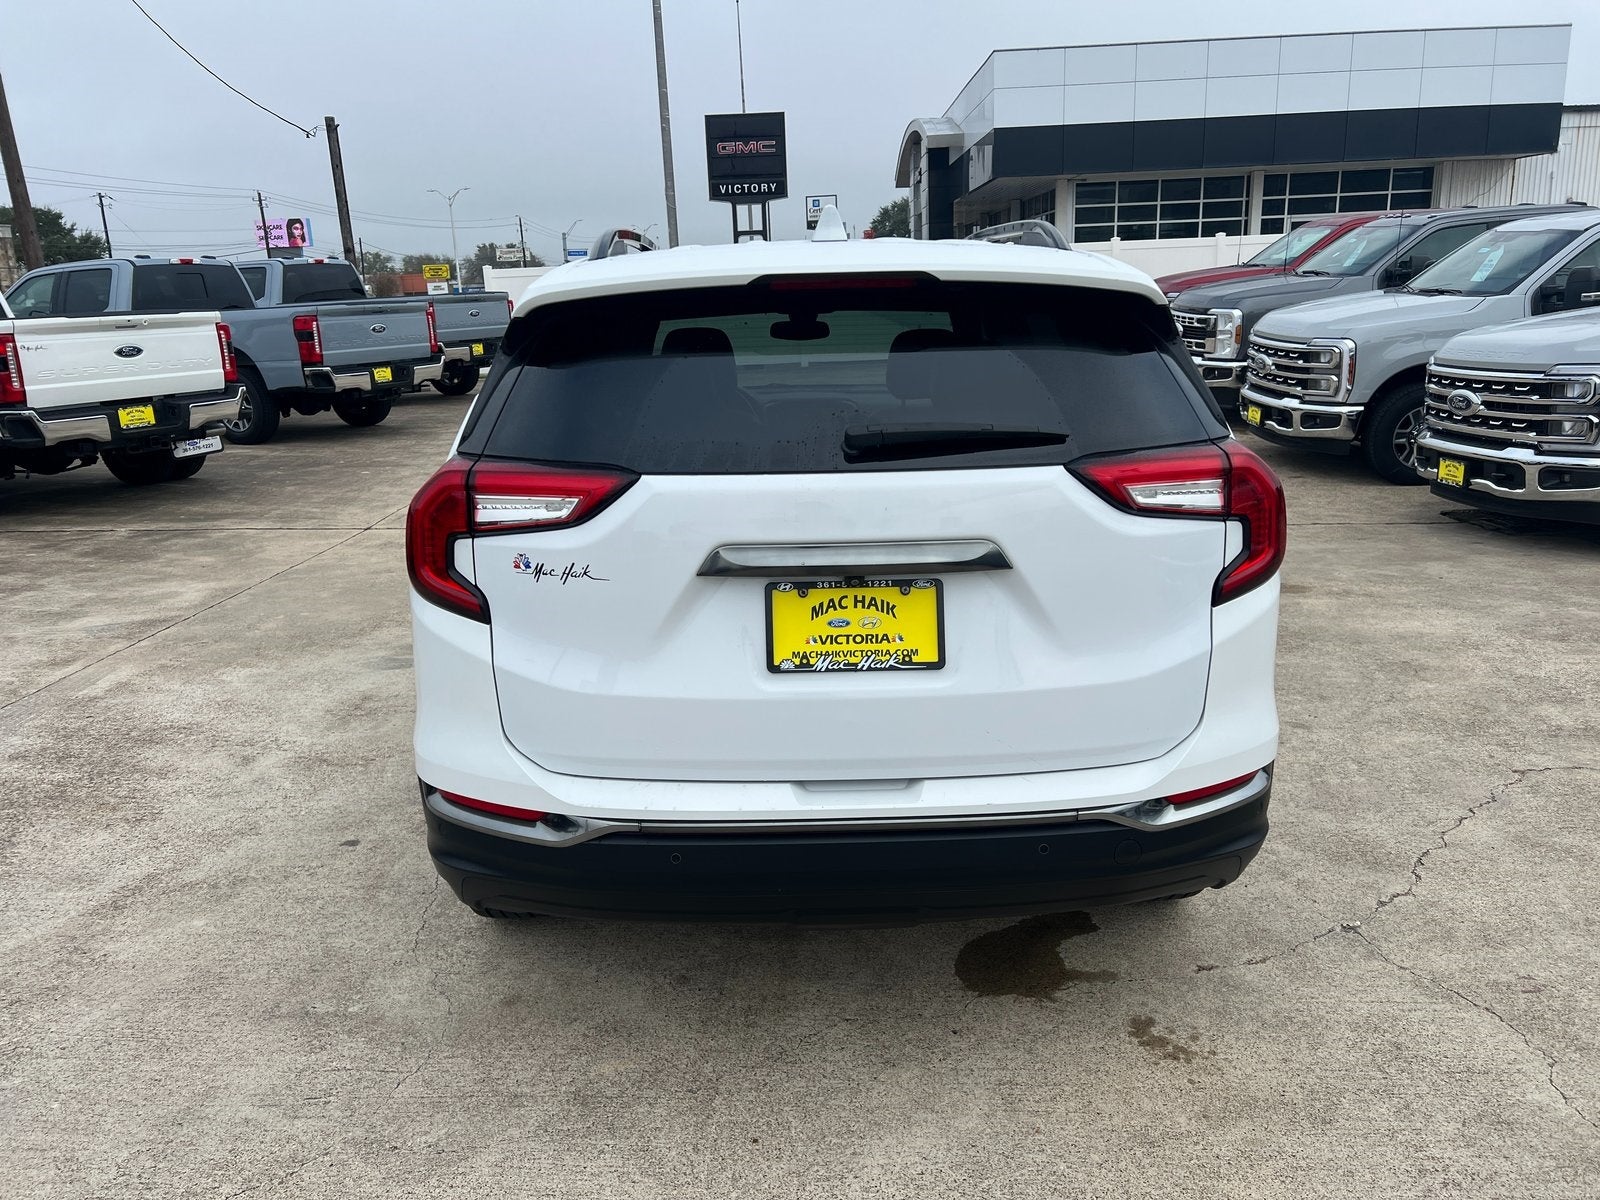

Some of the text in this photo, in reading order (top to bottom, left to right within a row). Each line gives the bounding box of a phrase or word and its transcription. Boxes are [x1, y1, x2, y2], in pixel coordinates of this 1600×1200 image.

[716, 141, 776, 155] GMC
[719, 183, 777, 194] VICTORY
[118, 345, 141, 357] Ford
[37, 357, 213, 380] SUPER DUTY
[532, 562, 609, 585] Mac Haik
[811, 594, 898, 621] MAC HAIK
[829, 618, 850, 628] Ford
[818, 633, 892, 646] VICTORIA
[812, 653, 922, 672] Mac Haik
